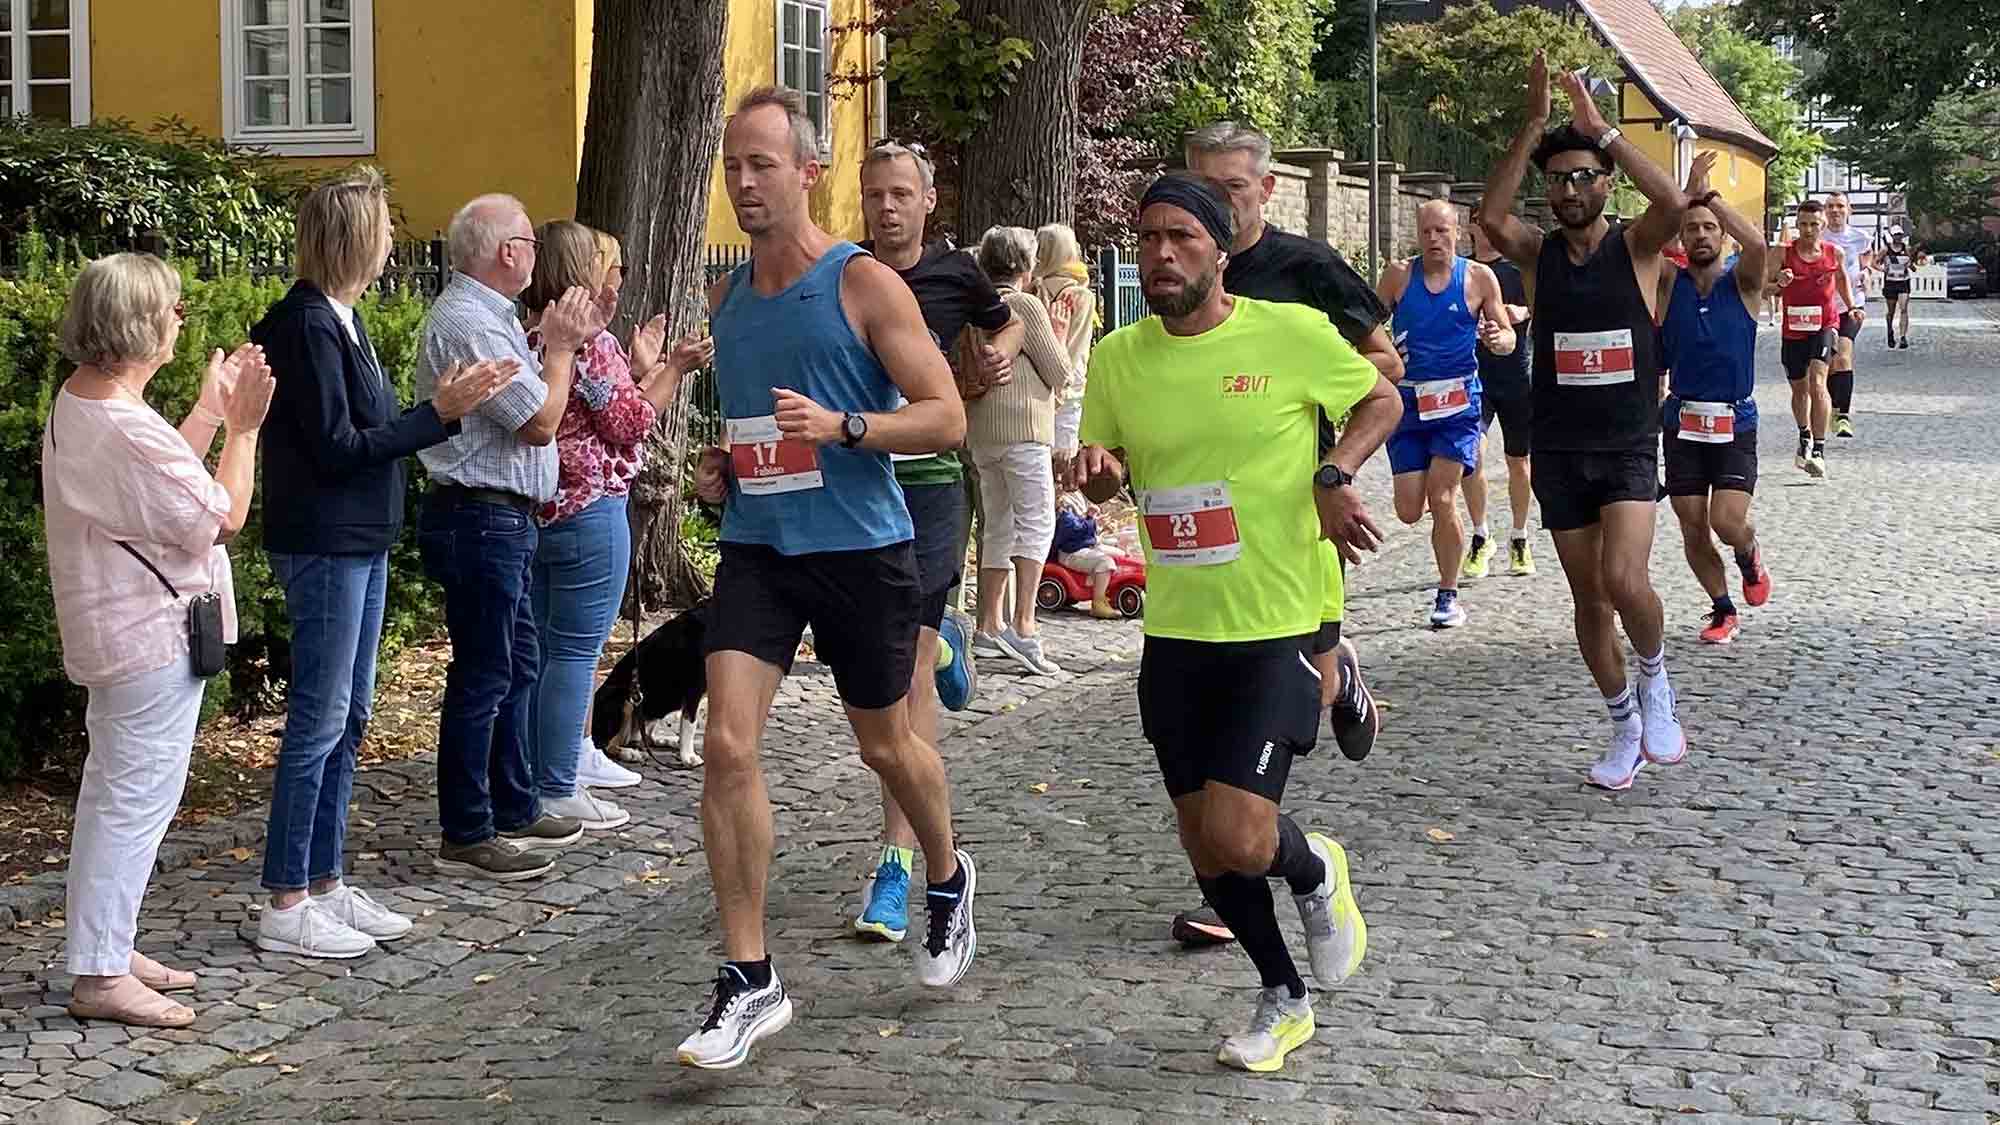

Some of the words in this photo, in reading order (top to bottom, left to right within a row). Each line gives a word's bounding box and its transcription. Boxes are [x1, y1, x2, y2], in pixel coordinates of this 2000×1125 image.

[1582, 351, 1602, 366] 21
[1700, 415, 1715, 428] 16
[753, 441, 778, 466] 17
[753, 466, 784, 477] Fabian
[1169, 514, 1198, 537] 23
[1256, 741, 1275, 775] FUSION
